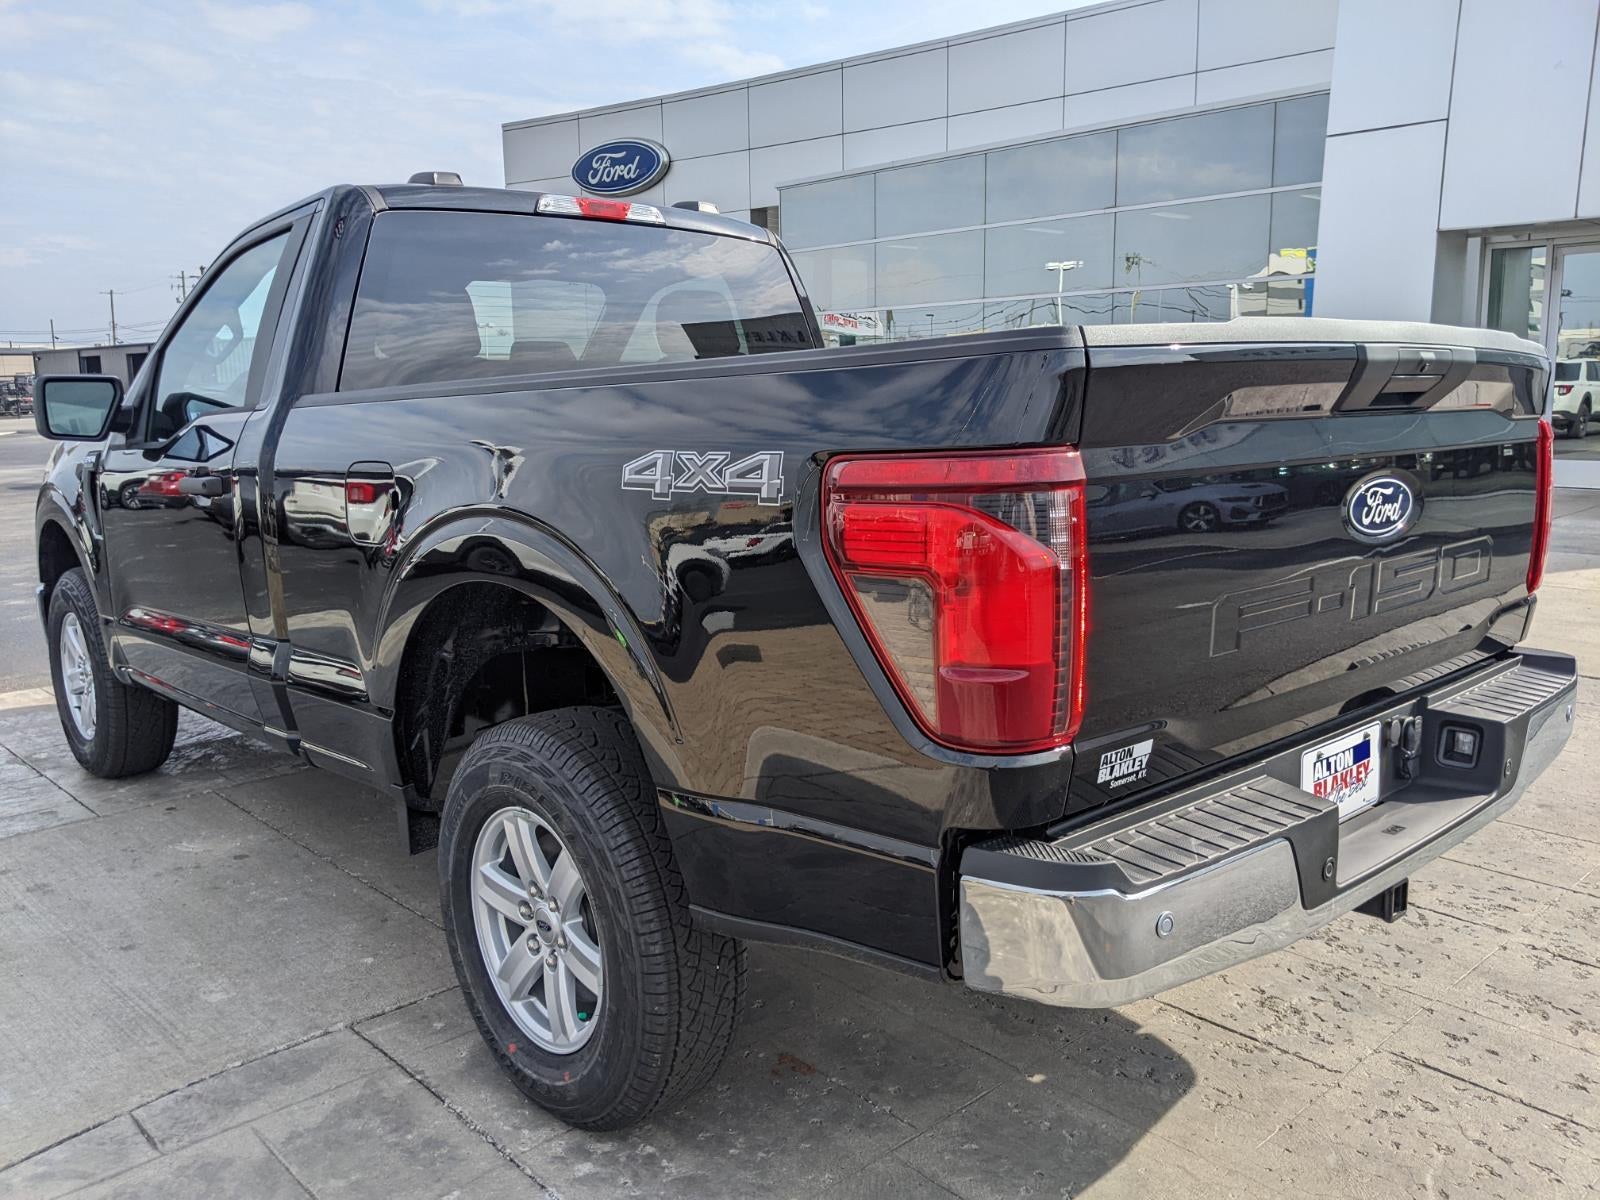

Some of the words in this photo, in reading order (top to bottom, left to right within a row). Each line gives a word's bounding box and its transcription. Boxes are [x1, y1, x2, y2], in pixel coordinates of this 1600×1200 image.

[587, 150, 640, 185] Ford
[1361, 486, 1403, 526] Ford
[1209, 534, 1494, 658] F-150
[1097, 753, 1150, 785] BLAKLEY
[1100, 745, 1135, 768] ALTON
[1313, 748, 1354, 781] ALTON
[1109, 773, 1137, 789] Somerset,
[1313, 759, 1371, 799] BLAKLEY
